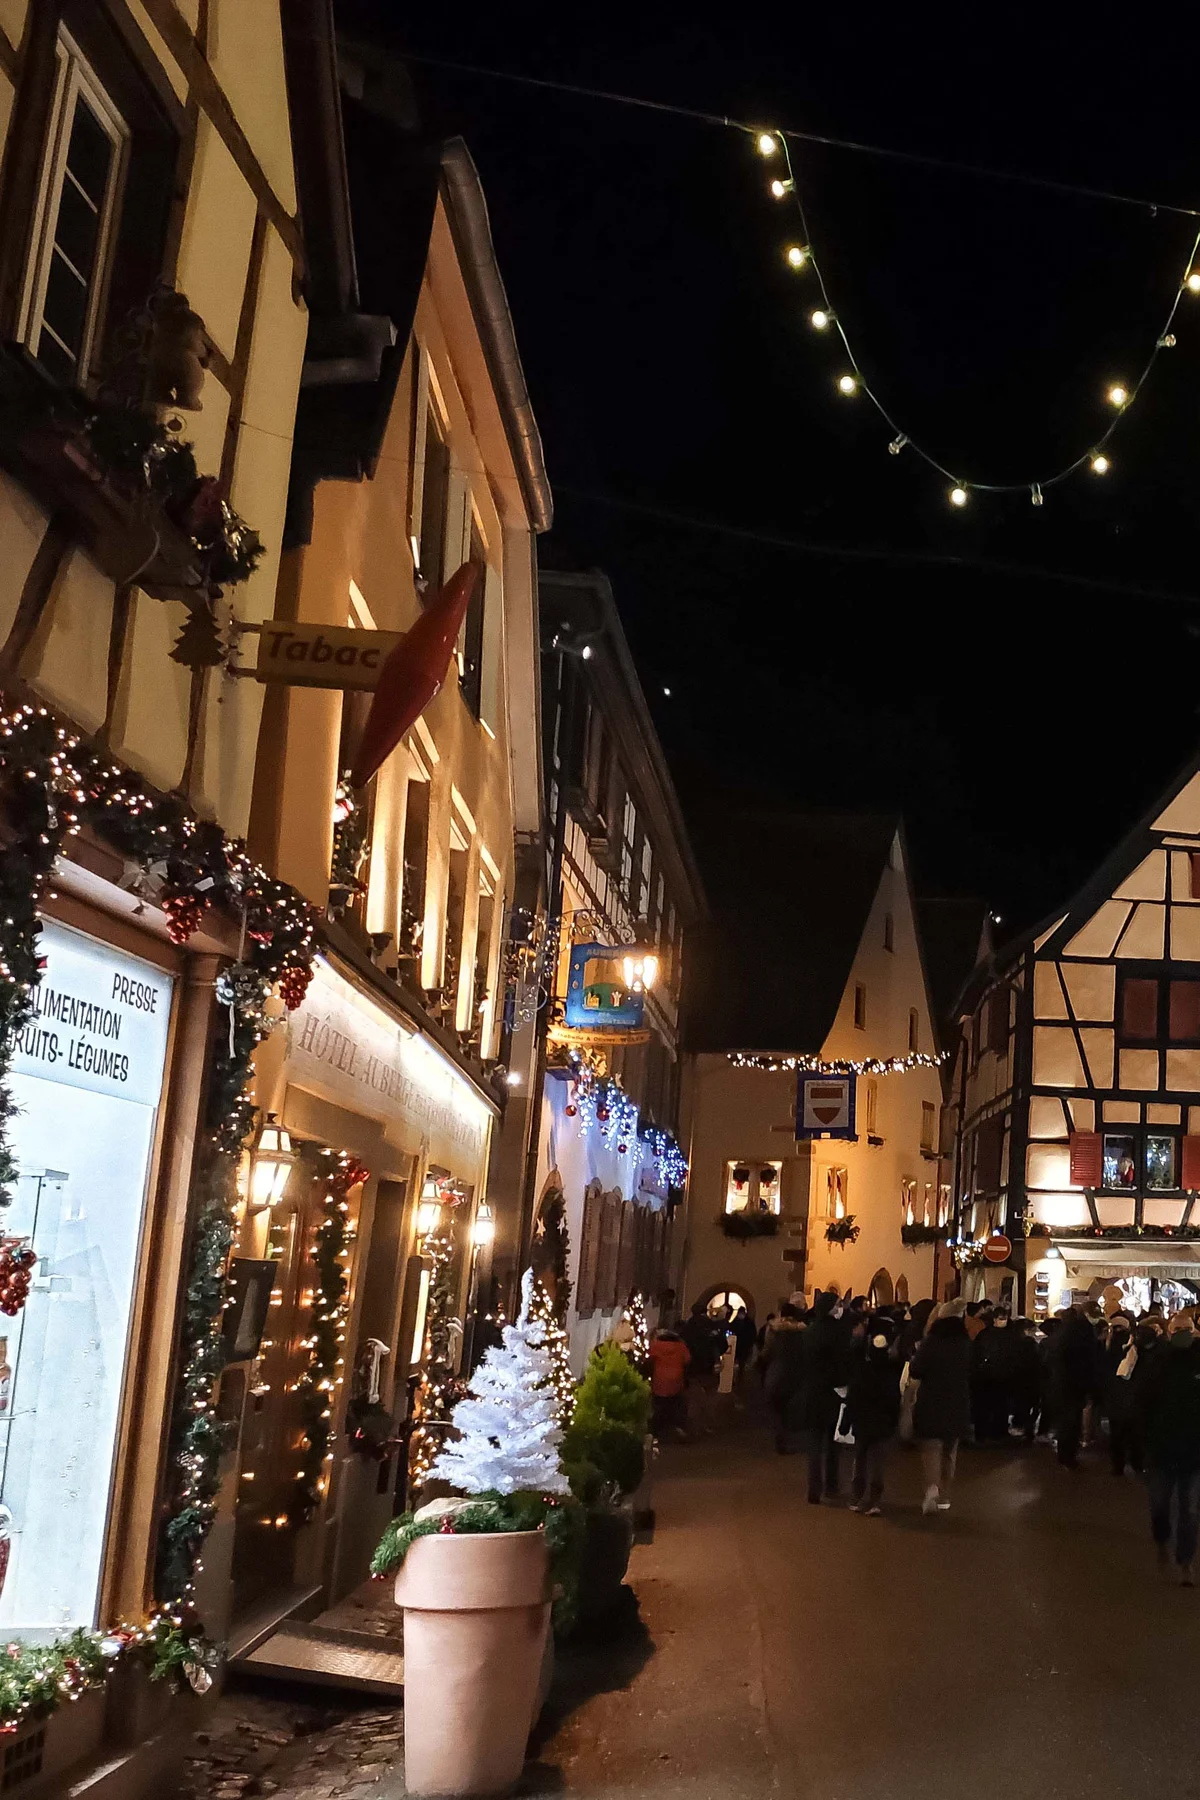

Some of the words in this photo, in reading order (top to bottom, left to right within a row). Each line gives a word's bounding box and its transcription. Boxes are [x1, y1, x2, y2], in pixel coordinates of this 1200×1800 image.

[267, 630, 381, 669] Tabac
[111, 972, 159, 1014] PRESSE
[8, 1026, 64, 1064] RUITS-
[68, 1034, 130, 1083] LÉGUMES
[297, 1012, 359, 1078] HÔTEL
